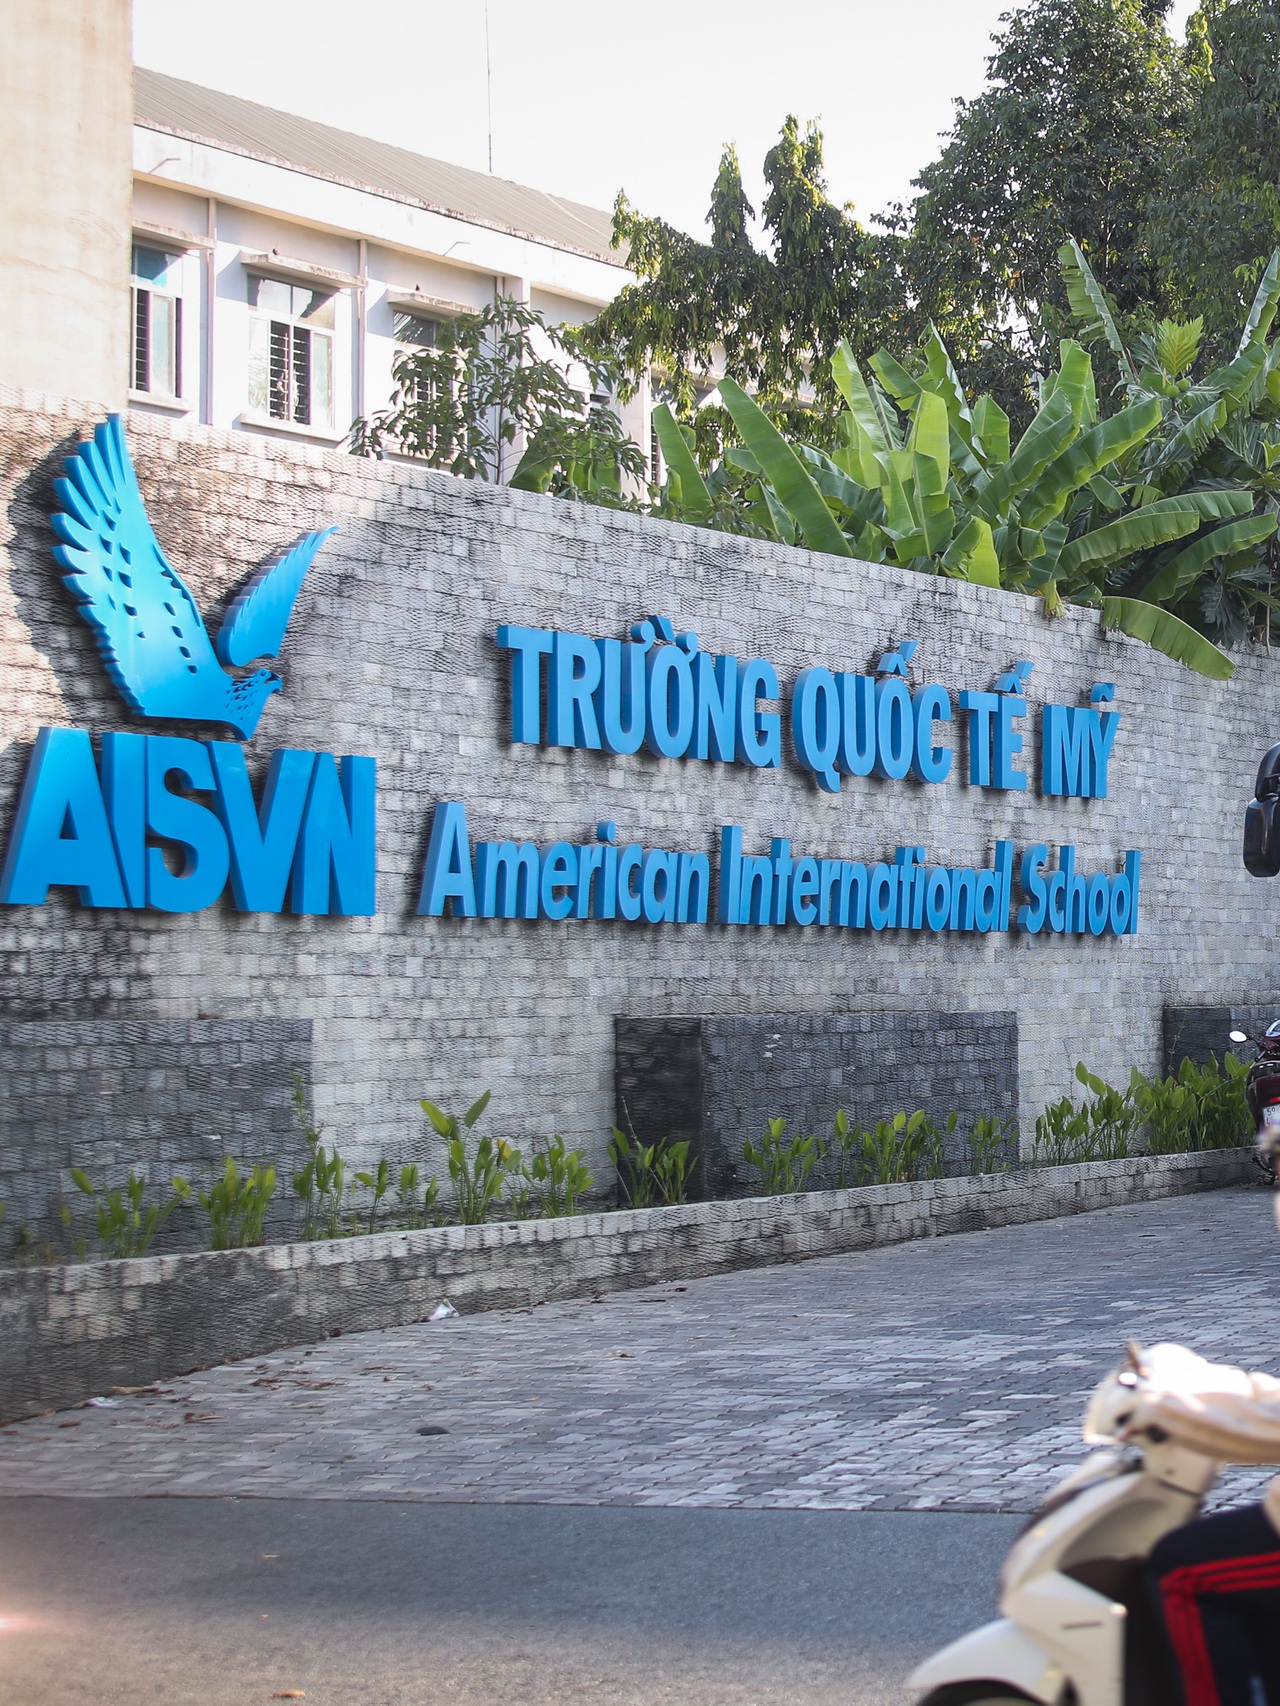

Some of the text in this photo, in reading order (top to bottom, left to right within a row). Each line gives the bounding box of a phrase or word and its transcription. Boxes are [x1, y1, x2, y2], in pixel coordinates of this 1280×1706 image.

[499, 615, 1120, 799] TRƯỜNG QUỐC TẾ MỸ
[2, 726, 376, 916] AISVN
[417, 801, 1141, 936] American International School
